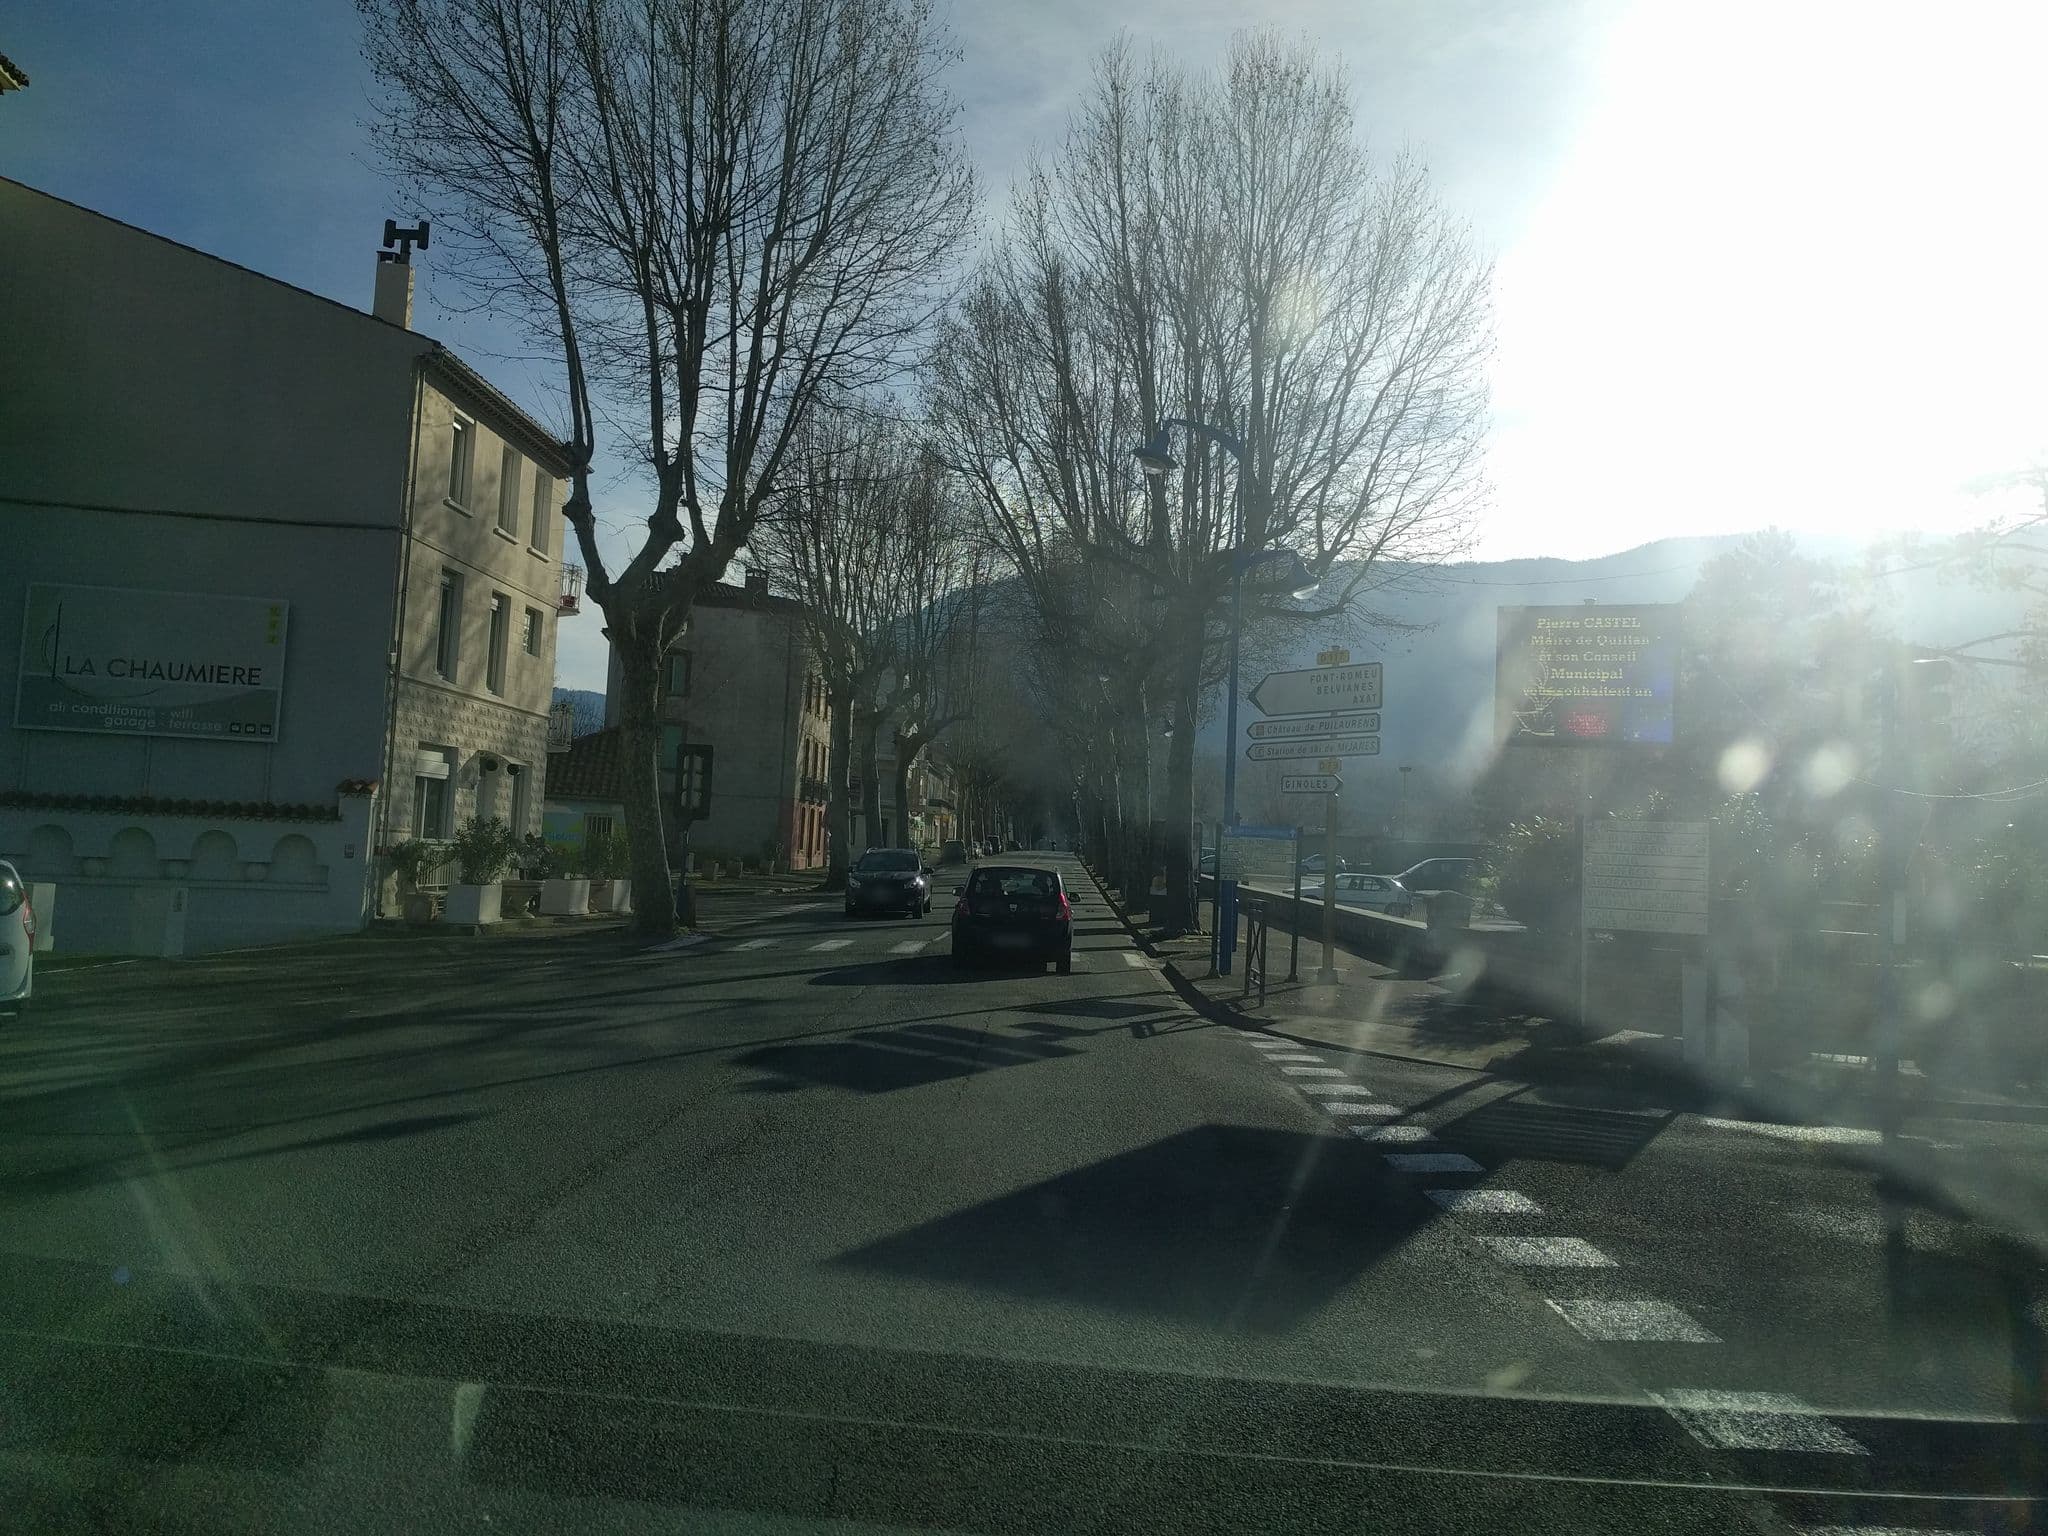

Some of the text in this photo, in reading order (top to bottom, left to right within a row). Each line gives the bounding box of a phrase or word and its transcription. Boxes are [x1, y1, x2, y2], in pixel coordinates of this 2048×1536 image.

[1536, 617, 1641, 629] Pierre CASTEL
[1530, 634, 1650, 647] Maire de Quillan
[1555, 652, 1579, 662] son
[1583, 651, 1637, 662] Conseil
[65, 655, 262, 687] LA CHAUMIERE
[1310, 669, 1377, 684] FONT-ROMEU
[1550, 668, 1624, 682] Municipal
[1353, 694, 1377, 704] AXAT
[103, 716, 156, 731] garage
[1319, 718, 1376, 730] PUILAURENS
[1284, 779, 1328, 790] GINOLES
